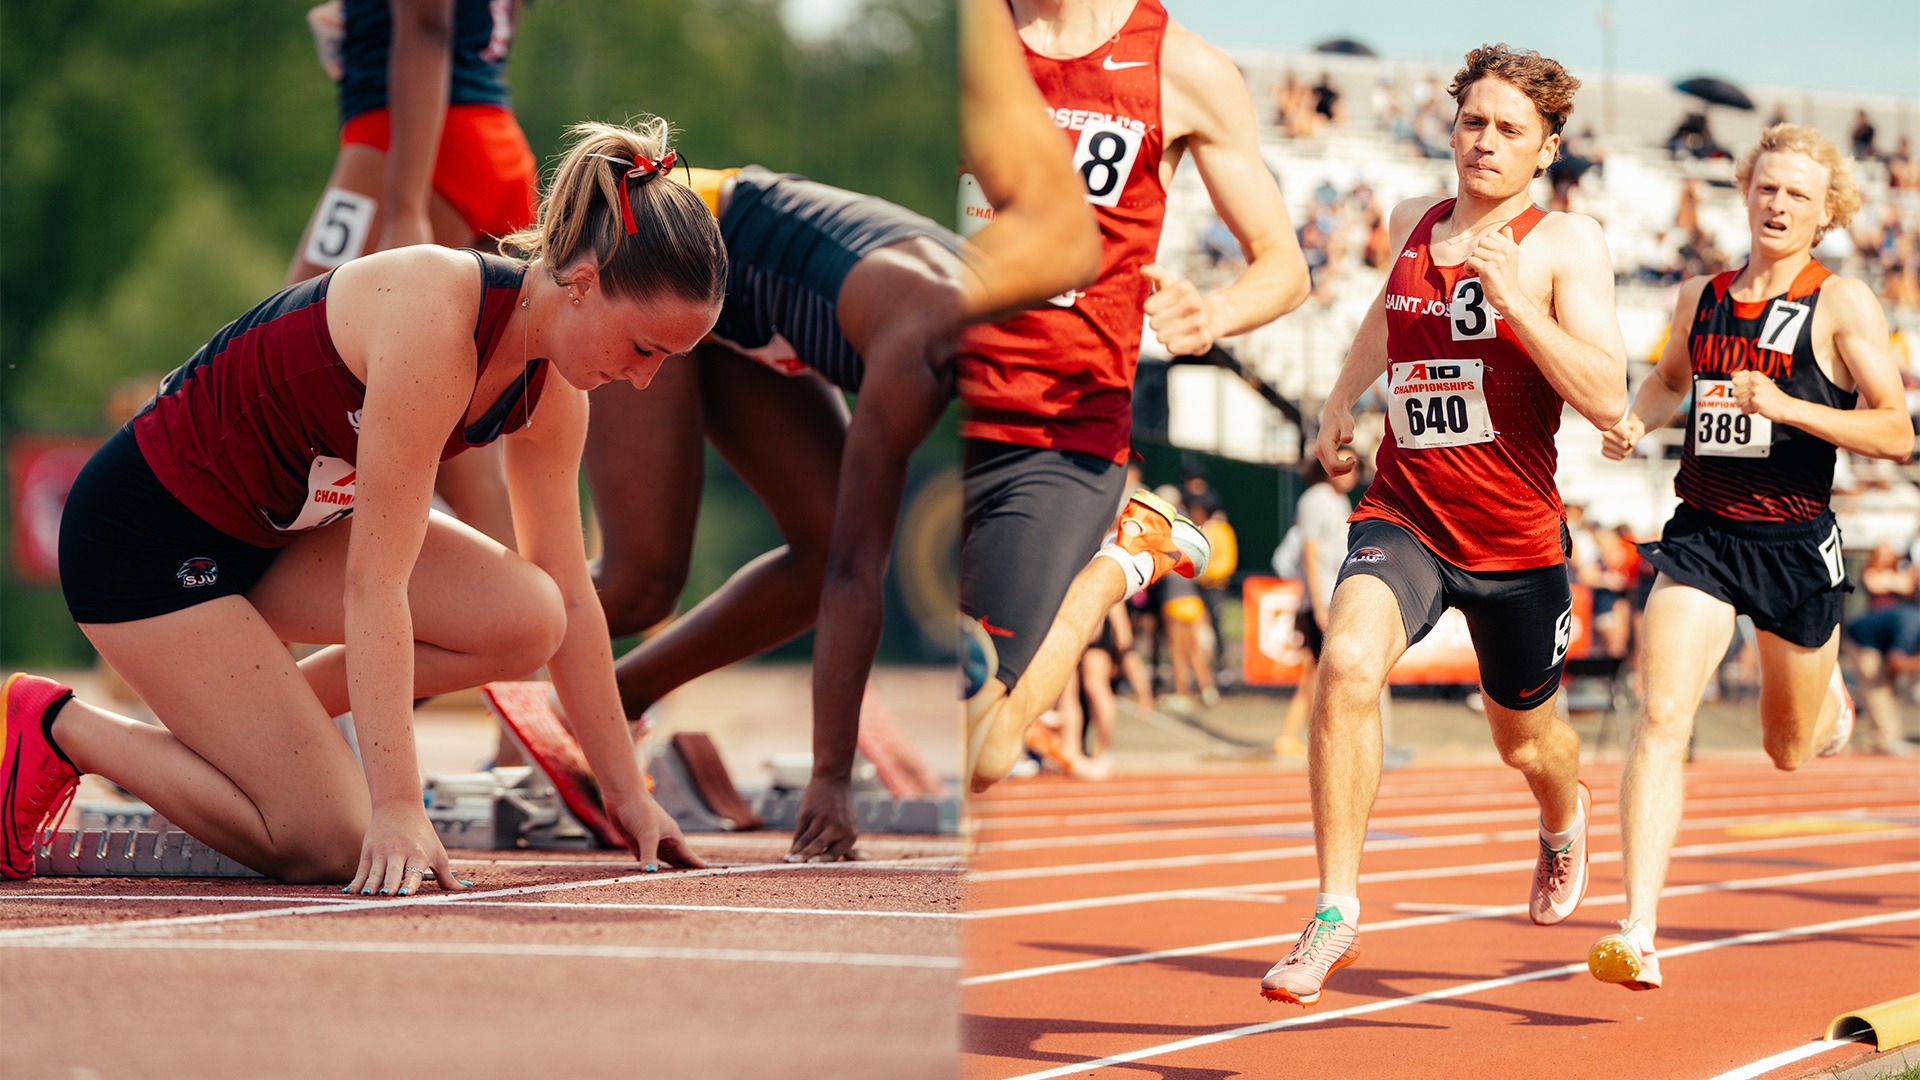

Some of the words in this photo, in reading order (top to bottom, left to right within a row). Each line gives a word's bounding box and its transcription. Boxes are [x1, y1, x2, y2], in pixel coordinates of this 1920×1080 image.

[1082, 131, 1126, 197] 8
[320, 201, 356, 257] 5
[1385, 294, 1422, 313] SAINT
[1455, 281, 1487, 337] 3
[1767, 305, 1800, 345] 7
[1691, 333, 1794, 379] DAVIDSON
[1393, 381, 1475, 395] CHAMPIONSHIPS
[1405, 363, 1461, 382] A10
[1405, 395, 1468, 436] 640
[1696, 401, 1741, 409] HAMPION
[1698, 413, 1751, 445] 389
[314, 490, 355, 506] CHAM
[185, 574, 217, 586] SJU
